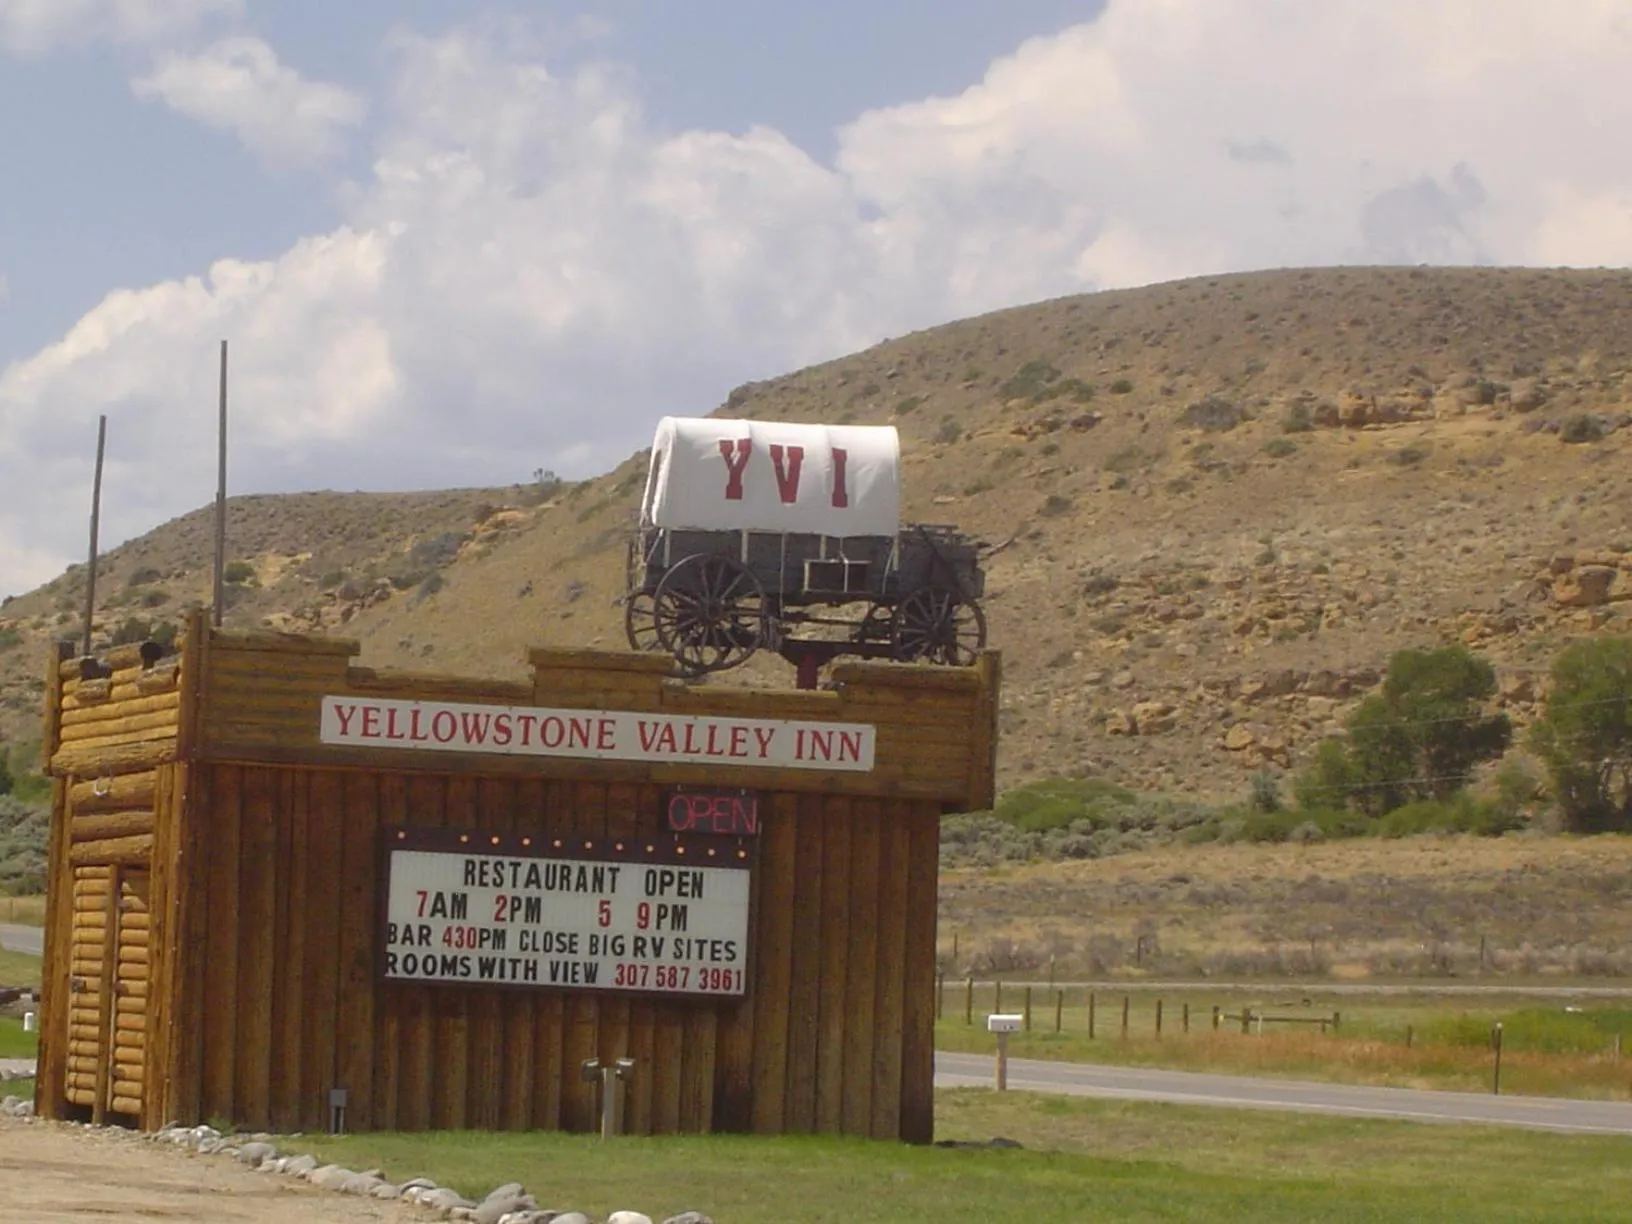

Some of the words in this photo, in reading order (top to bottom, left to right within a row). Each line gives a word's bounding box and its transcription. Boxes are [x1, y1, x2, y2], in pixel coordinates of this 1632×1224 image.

[334, 704, 616, 751] YELLOWSTONE
[638, 721, 775, 758] VALLEY
[794, 729, 863, 762] INN
[668, 795, 757, 833] OPEN
[464, 859, 620, 893] RESTAURANT
[645, 869, 704, 898] OPEN
[415, 891, 468, 920] 7AM
[494, 895, 542, 924] 2PM
[599, 900, 611, 927] 5
[388, 922, 431, 947] BAR
[442, 927, 506, 951] 430PM
[519, 930, 579, 955] CLOSE
[589, 934, 625, 957] BIG
[633, 936, 665, 959] RV
[673, 939, 737, 962] SITES
[385, 952, 470, 978] ROOMS
[478, 957, 538, 981] WITH
[550, 961, 599, 984] VIEW
[615, 963, 649, 987] 307
[656, 966, 689, 989] 587
[699, 968, 742, 991] 3961
